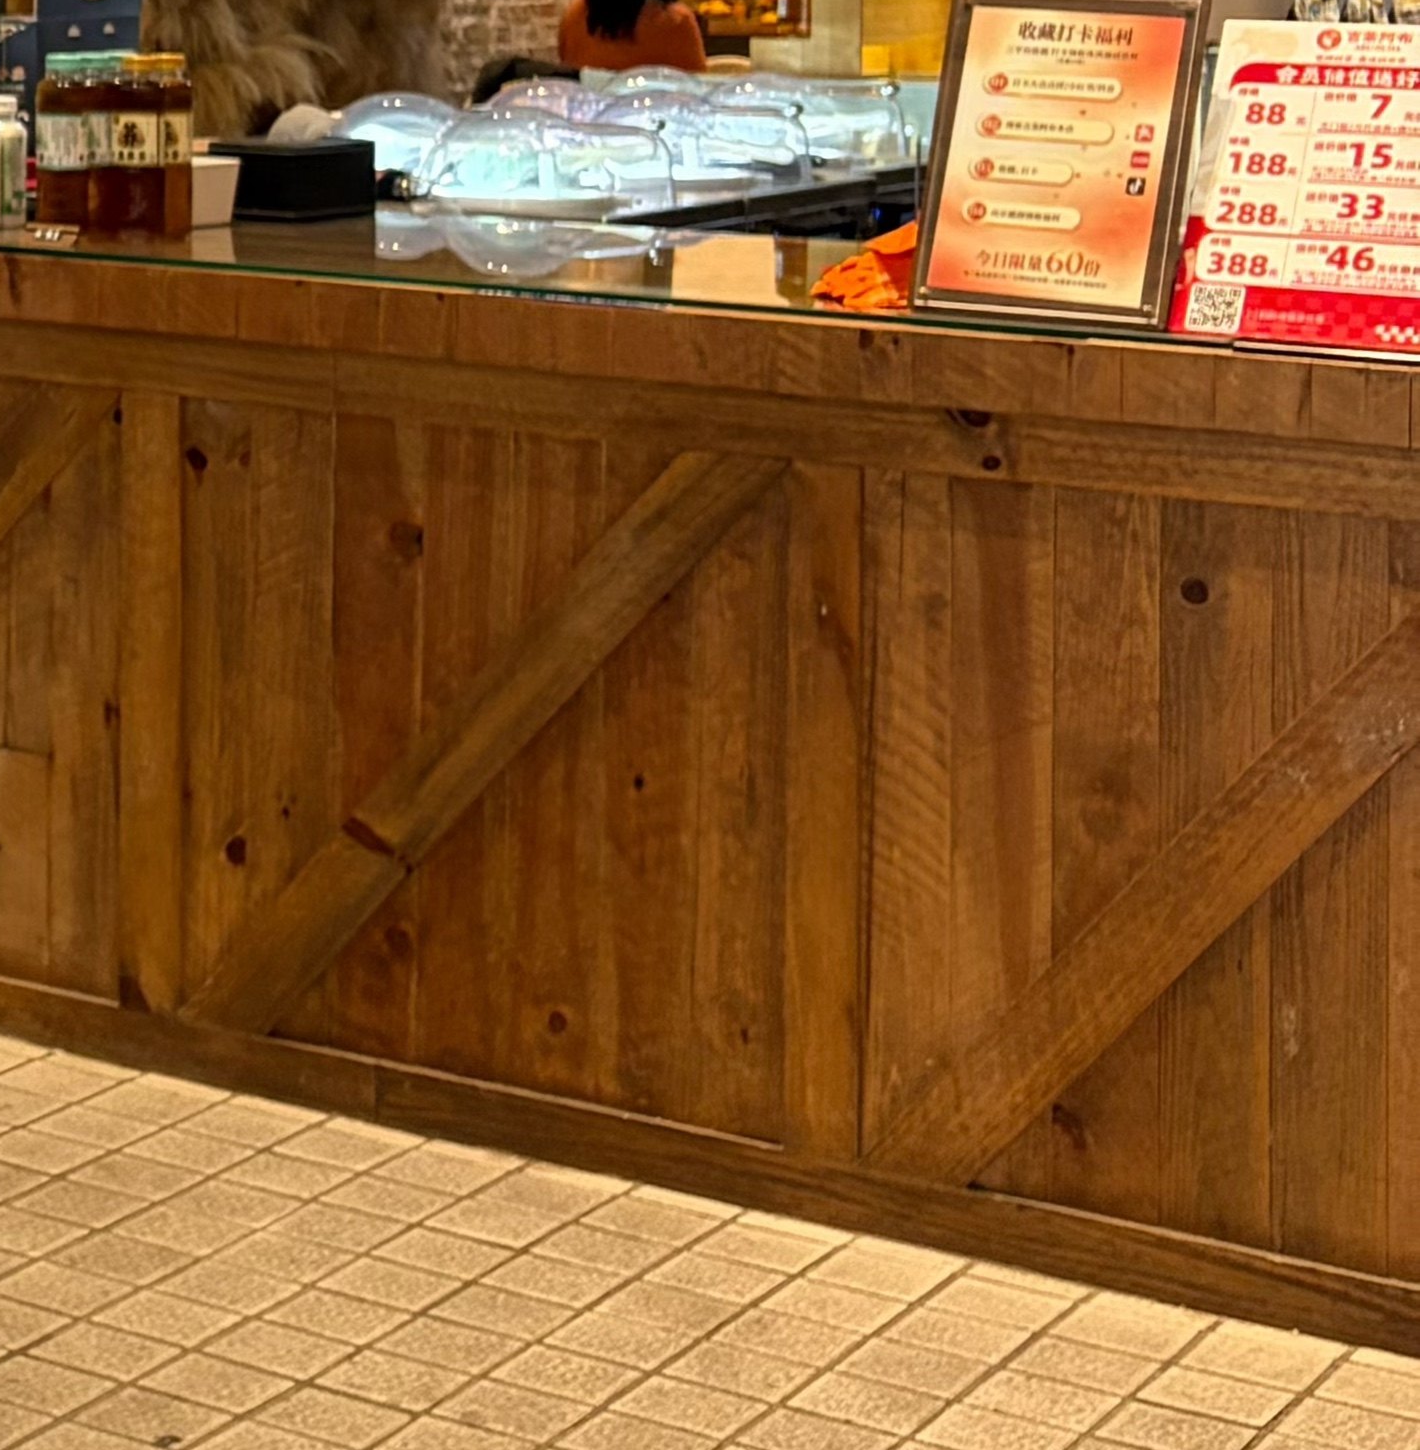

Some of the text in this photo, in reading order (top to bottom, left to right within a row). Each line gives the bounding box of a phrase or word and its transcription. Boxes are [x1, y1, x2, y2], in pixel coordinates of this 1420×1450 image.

[1019, 20, 1134, 46] 收藏打卡福利
[1245, 102, 1287, 126] 88
[975, 248, 1102, 278] 今日限量60份
